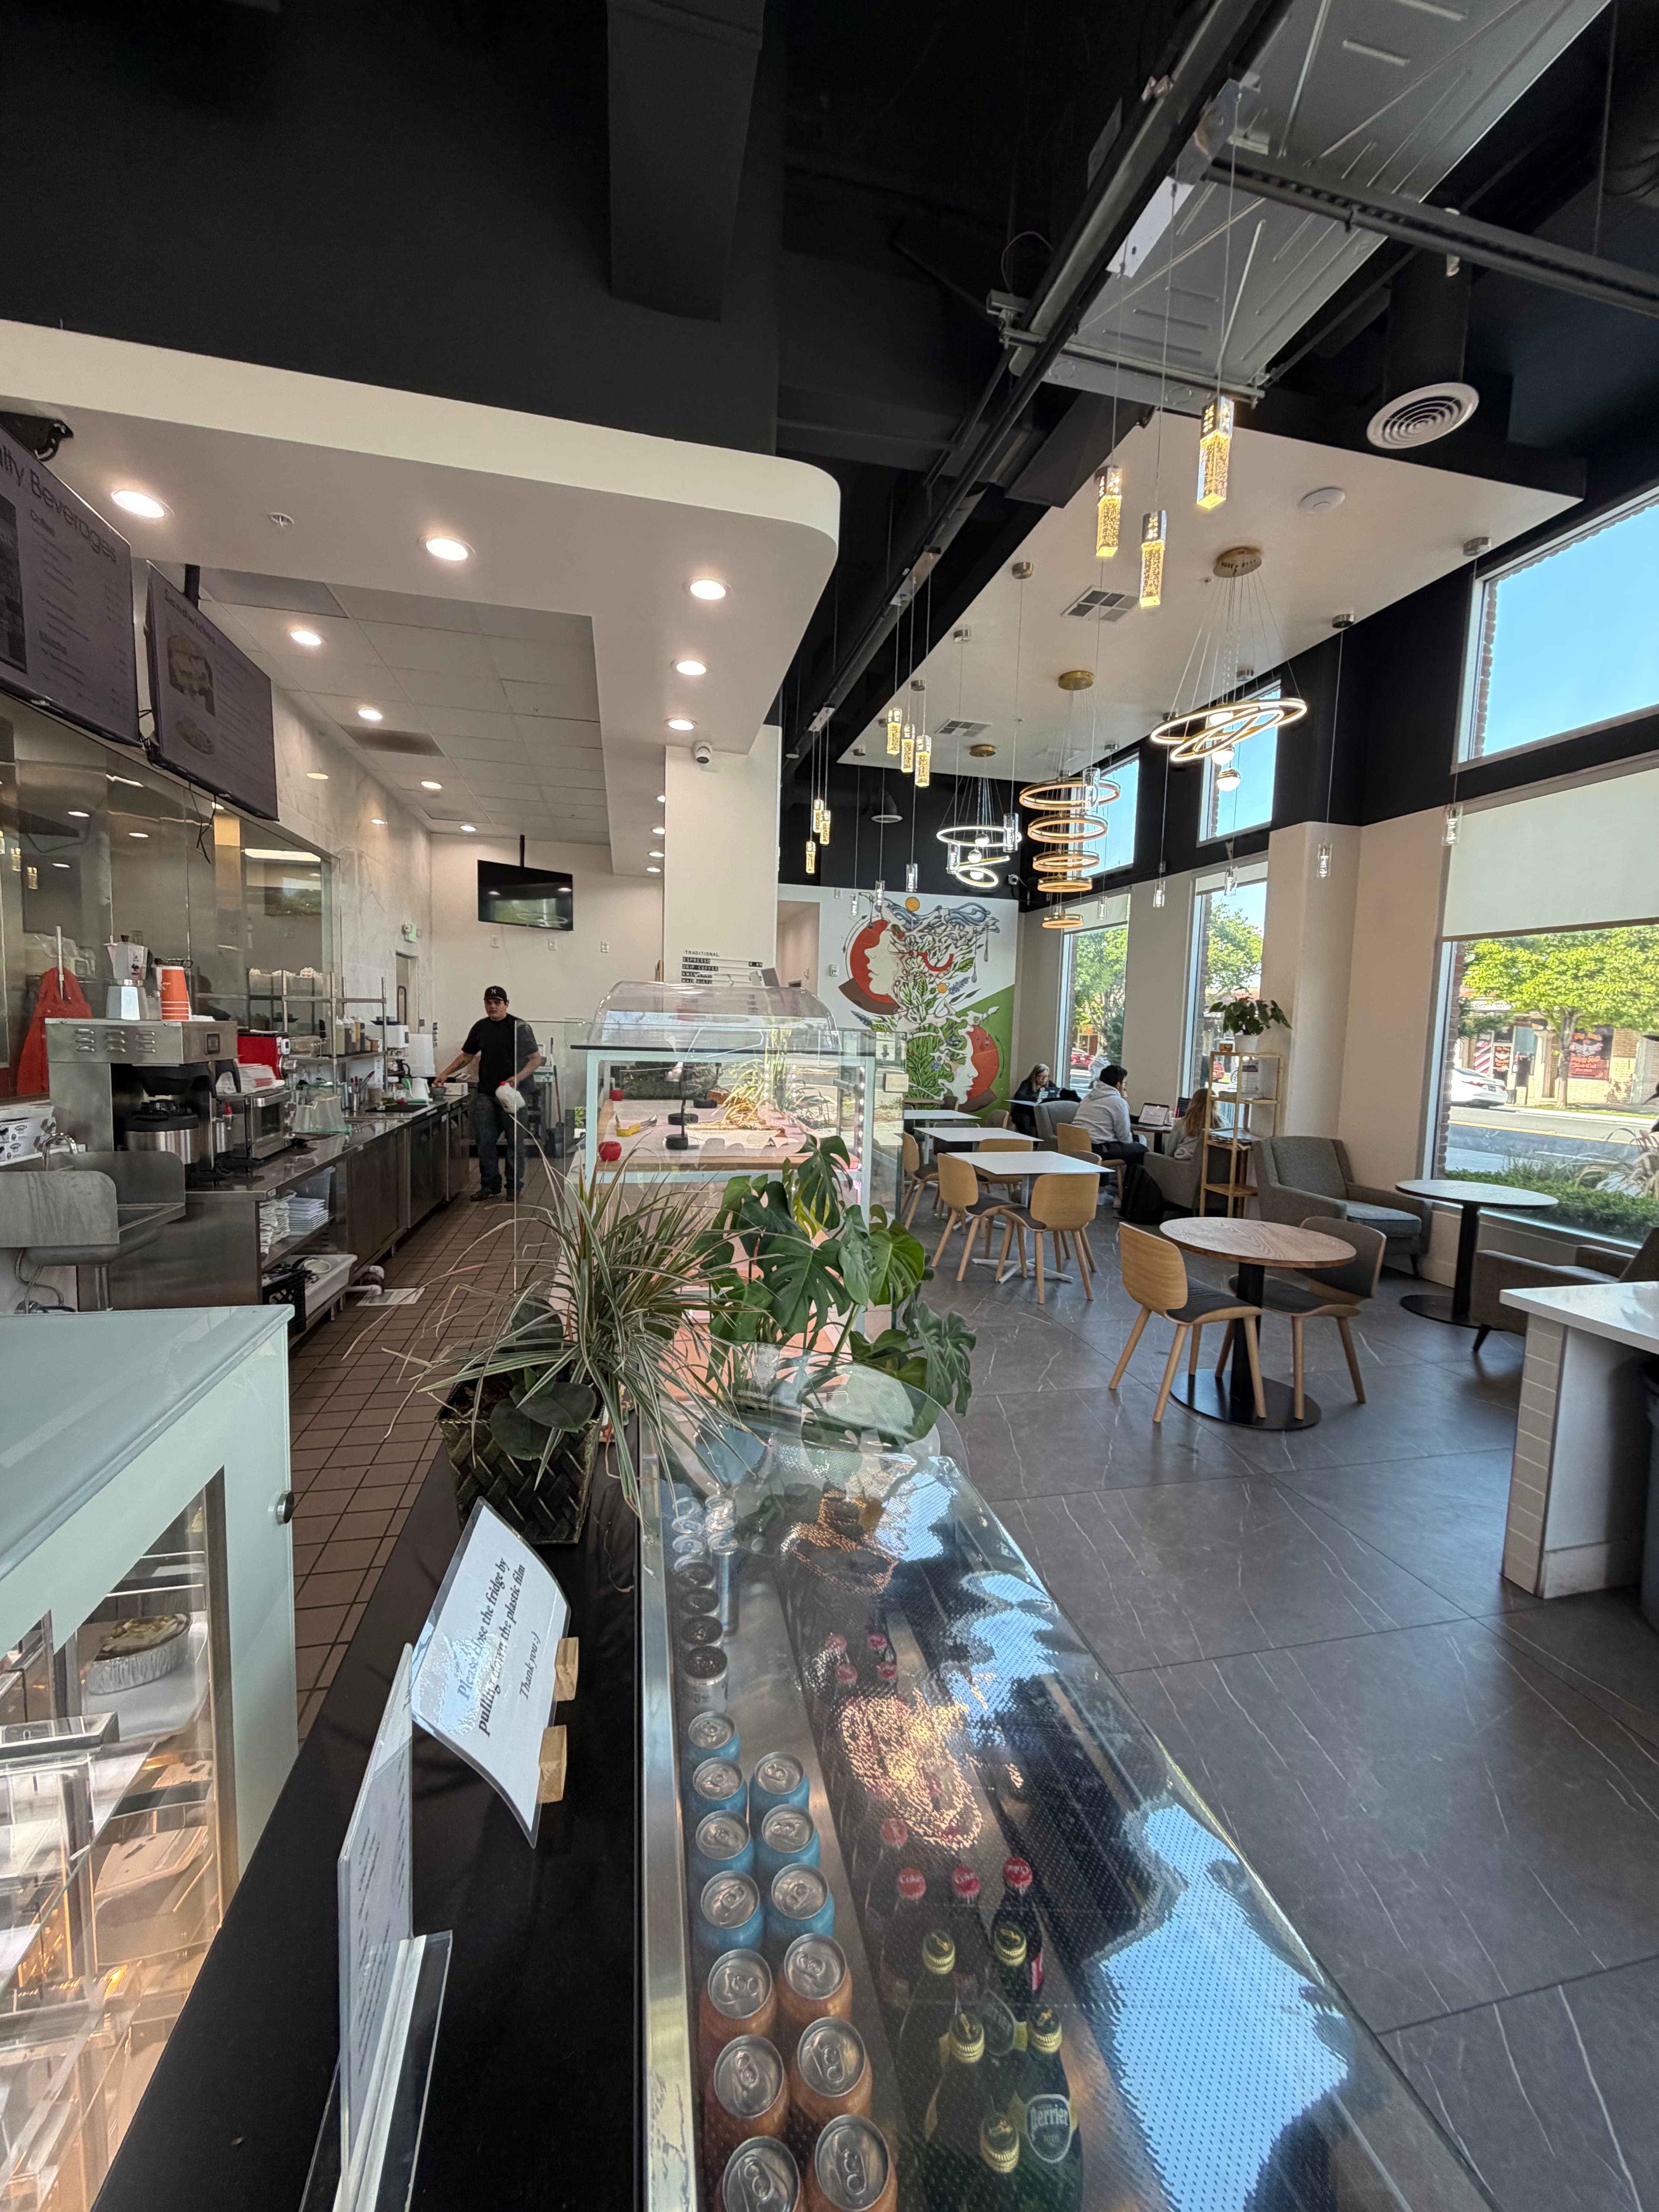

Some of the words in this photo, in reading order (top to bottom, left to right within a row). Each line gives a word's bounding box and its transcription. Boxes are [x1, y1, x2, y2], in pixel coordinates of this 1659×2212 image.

[30, 469, 117, 563] Beverages
[495, 1557, 510, 1573] by
[512, 1564, 525, 1586] film
[485, 1572, 505, 1606] fridge
[505, 1585, 520, 1625] plastic
[480, 1605, 494, 1626] the
[499, 1621, 512, 1641] the
[474, 1626, 488, 1657] close
[490, 1642, 506, 1678] down
[457, 1656, 479, 1700] Please
[519, 1662, 534, 1700] Thank
[478, 1678, 501, 1738] pulling
[899, 1875, 921, 1884] Coke
[954, 1872, 976, 1884] Coke
[1030, 2104, 1069, 2142] Perrier
